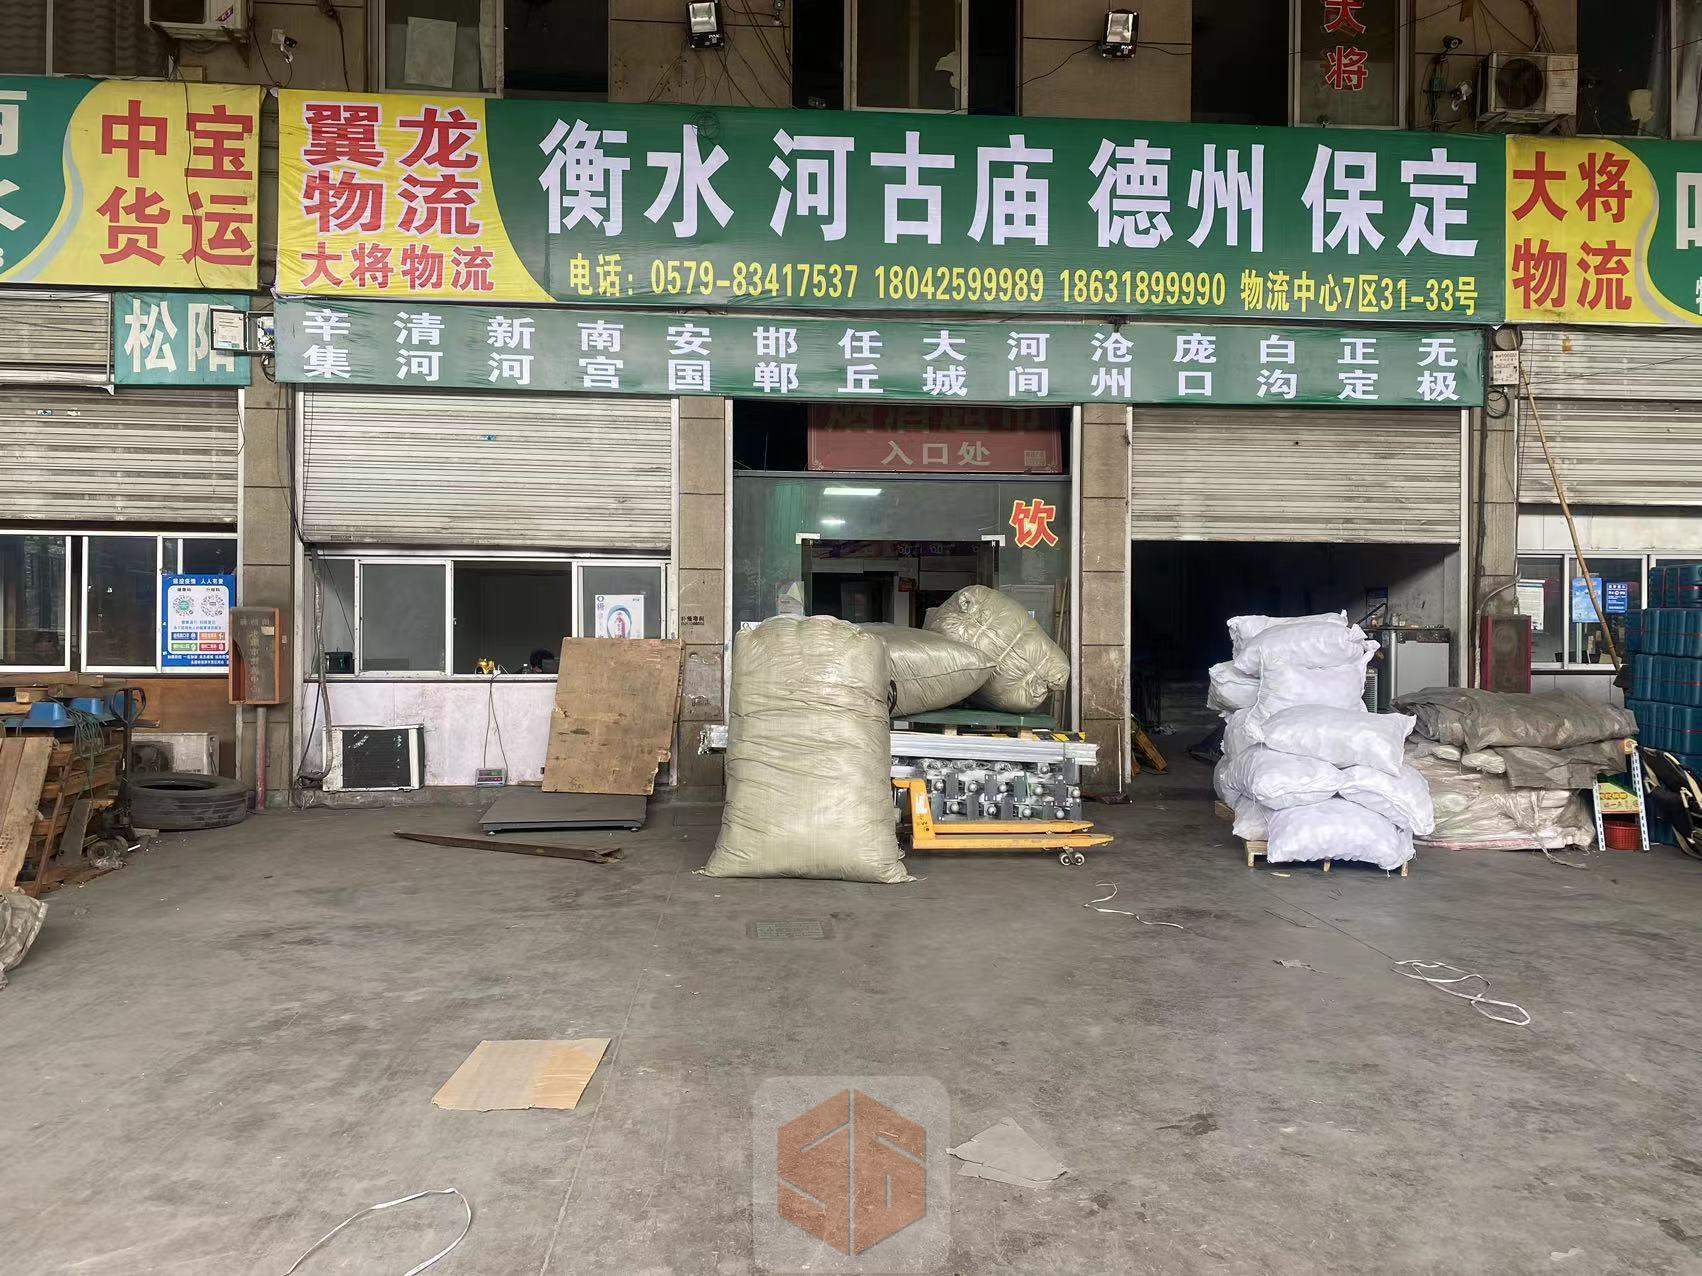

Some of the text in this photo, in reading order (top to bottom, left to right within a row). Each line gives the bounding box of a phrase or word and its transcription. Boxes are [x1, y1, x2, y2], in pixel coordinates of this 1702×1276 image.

[1324, 0, 1368, 91] 大将
[303, 104, 480, 169] 翼龙
[302, 169, 480, 235] 物流
[538, 118, 1479, 257] 衡水 河古庙 德州 保定
[1511, 151, 1633, 224] 大将
[97, 186, 255, 266] 货运
[300, 241, 495, 292] 大将物流
[650, 259, 858, 298] 0579-83417537
[874, 265, 1045, 302] 18042599989
[1059, 269, 1227, 305] 18631899990
[1239, 269, 1478, 316] 物流中心7区31-33号
[1512, 238, 1633, 311] 物流
[302, 309, 352, 380] 辛集
[393, 311, 445, 383] 清河
[486, 315, 536, 386] 新河
[577, 319, 624, 390] 南宫
[666, 323, 712, 392] 安国
[753, 326, 799, 393] 邯郸
[838, 328, 884, 394] 任丘
[922, 330, 968, 397] 大城
[1007, 331, 1050, 397] 河间
[1090, 332, 1134, 398] 沧州
[1173, 333, 1217, 397] 庞口
[1256, 334, 1298, 399] 白沟
[1337, 337, 1380, 400] 正定
[1416, 338, 1460, 402] 无极
[881, 440, 992, 467] 入口处
[1008, 497, 1059, 549] 饮
